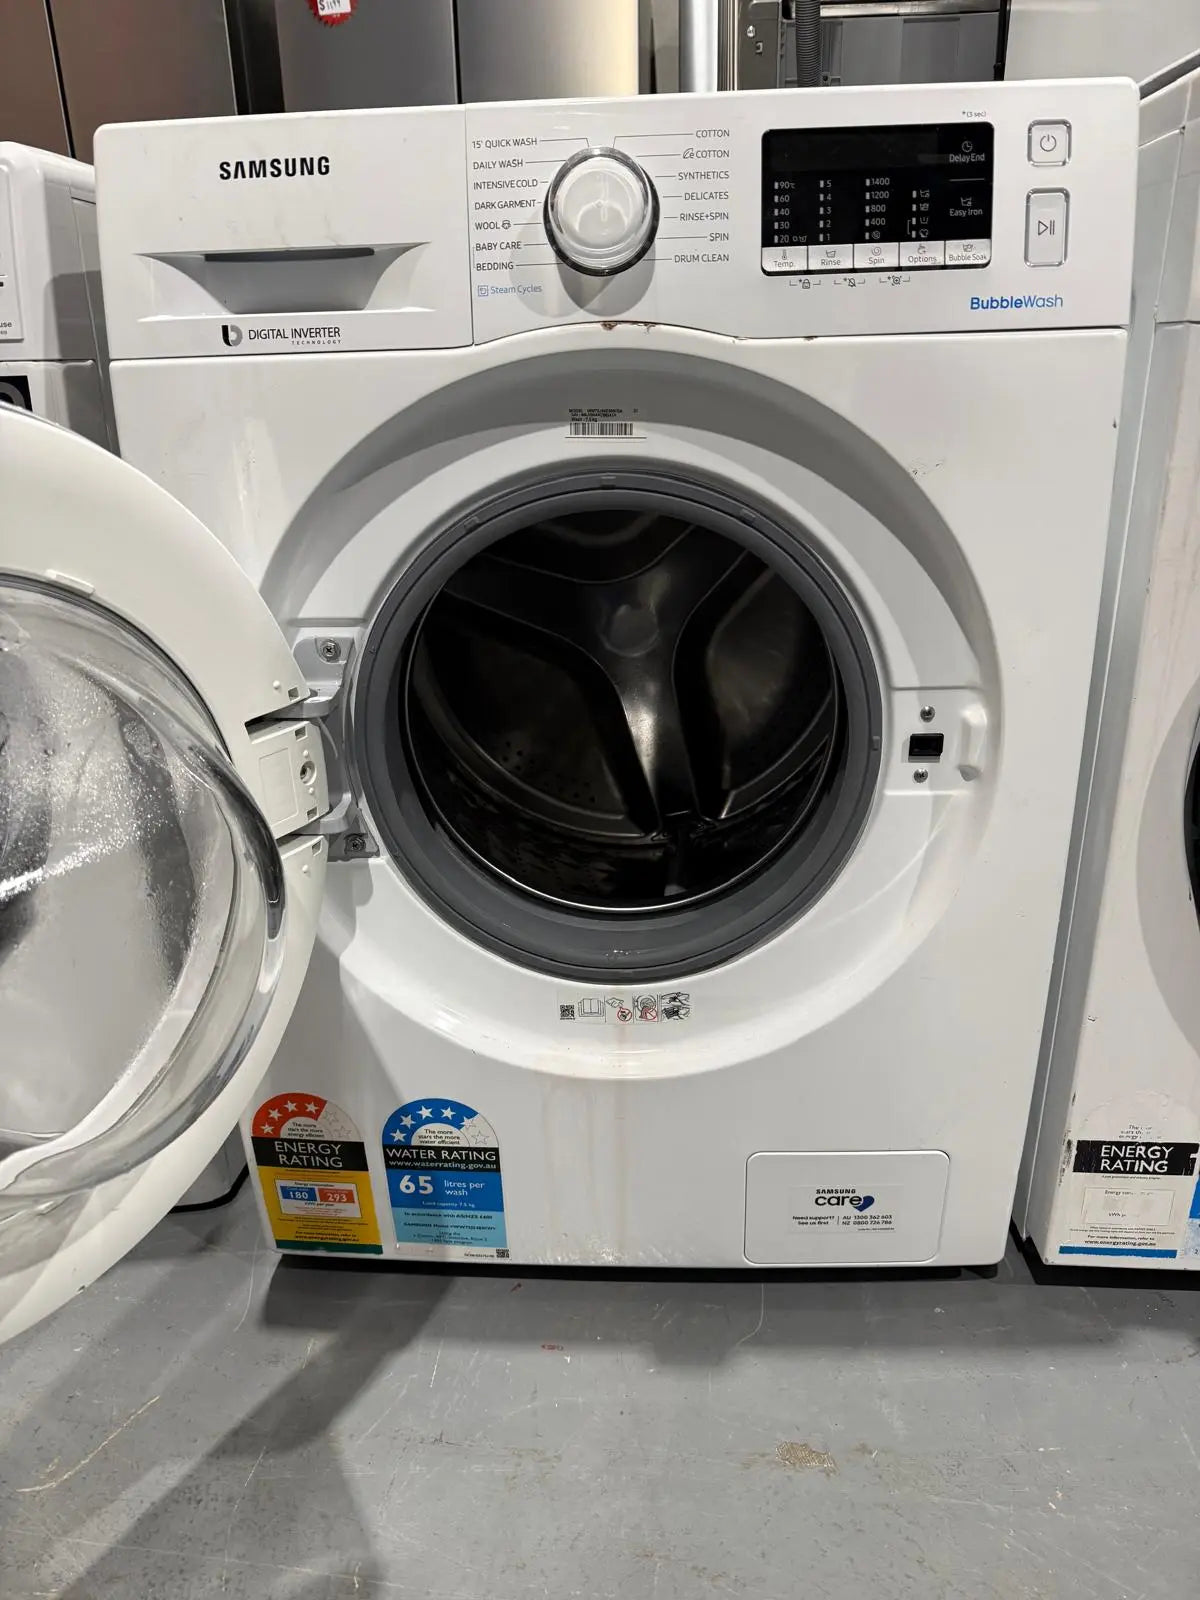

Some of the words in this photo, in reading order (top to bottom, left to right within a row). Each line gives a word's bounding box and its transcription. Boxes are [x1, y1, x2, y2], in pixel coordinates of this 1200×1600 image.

[696, 129, 730, 139] COTTON
[485, 138, 511, 148] QUICK
[512, 137, 538, 147] WASH
[948, 154, 970, 164] Delay
[970, 153, 985, 162] End
[219, 156, 330, 180] SAMSUNG
[473, 160, 496, 170] DAILY
[498, 158, 524, 168] WASH
[678, 171, 730, 181] SYNTHETICS
[474, 180, 516, 190] INTENSIVE
[516, 178, 538, 188] COLD
[826, 180, 832, 188] 5
[871, 178, 890, 186] 1400
[684, 192, 729, 201] DELICATES
[780, 194, 790, 202] 60
[826, 193, 832, 201] 4
[871, 191, 890, 200] 1200
[474, 200, 497, 210] DARK
[497, 199, 536, 209] GARMENT
[870, 204, 886, 213] 800
[780, 208, 790, 216] 40
[826, 206, 832, 214] 3
[949, 208, 968, 218] Easy
[968, 208, 983, 216] Iron
[679, 212, 729, 222] RINSE+SPIN
[870, 218, 886, 226] 400
[474, 221, 500, 230] WOOL
[780, 222, 790, 230] 30
[826, 220, 832, 228] 2
[709, 232, 730, 242] SPIN
[780, 235, 790, 243] 20
[475, 242, 498, 252] BABY
[498, 241, 522, 250] CARE
[674, 254, 700, 264] DRUM
[701, 254, 730, 264] CLEAN
[868, 257, 885, 265] Spin
[908, 256, 937, 264] Options
[948, 254, 971, 262] Bubble
[476, 262, 514, 272] BEDDING
[490, 286, 516, 295] Steam
[516, 284, 542, 296] Cycles
[970, 294, 1064, 310] BubbleWash
[248, 328, 289, 340] DIGITAL
[290, 326, 341, 338] INVERTER
[274, 1141, 342, 1155] ENERGY
[1101, 1145, 1174, 1159] ENERGY
[386, 1148, 437, 1160] WATER
[441, 1150, 496, 1161] RATING
[279, 1154, 343, 1168] RATING
[389, 1160, 497, 1170] www.waterrating.gov.au
[1100, 1159, 1168, 1173] RATING
[399, 1174, 434, 1195] 65
[444, 1179, 467, 1189] litres
[469, 1182, 485, 1191] per
[290, 1191, 308, 1199] 180
[444, 1188, 468, 1196] wash
[327, 1194, 348, 1202] 293
[814, 1196, 862, 1206] care
